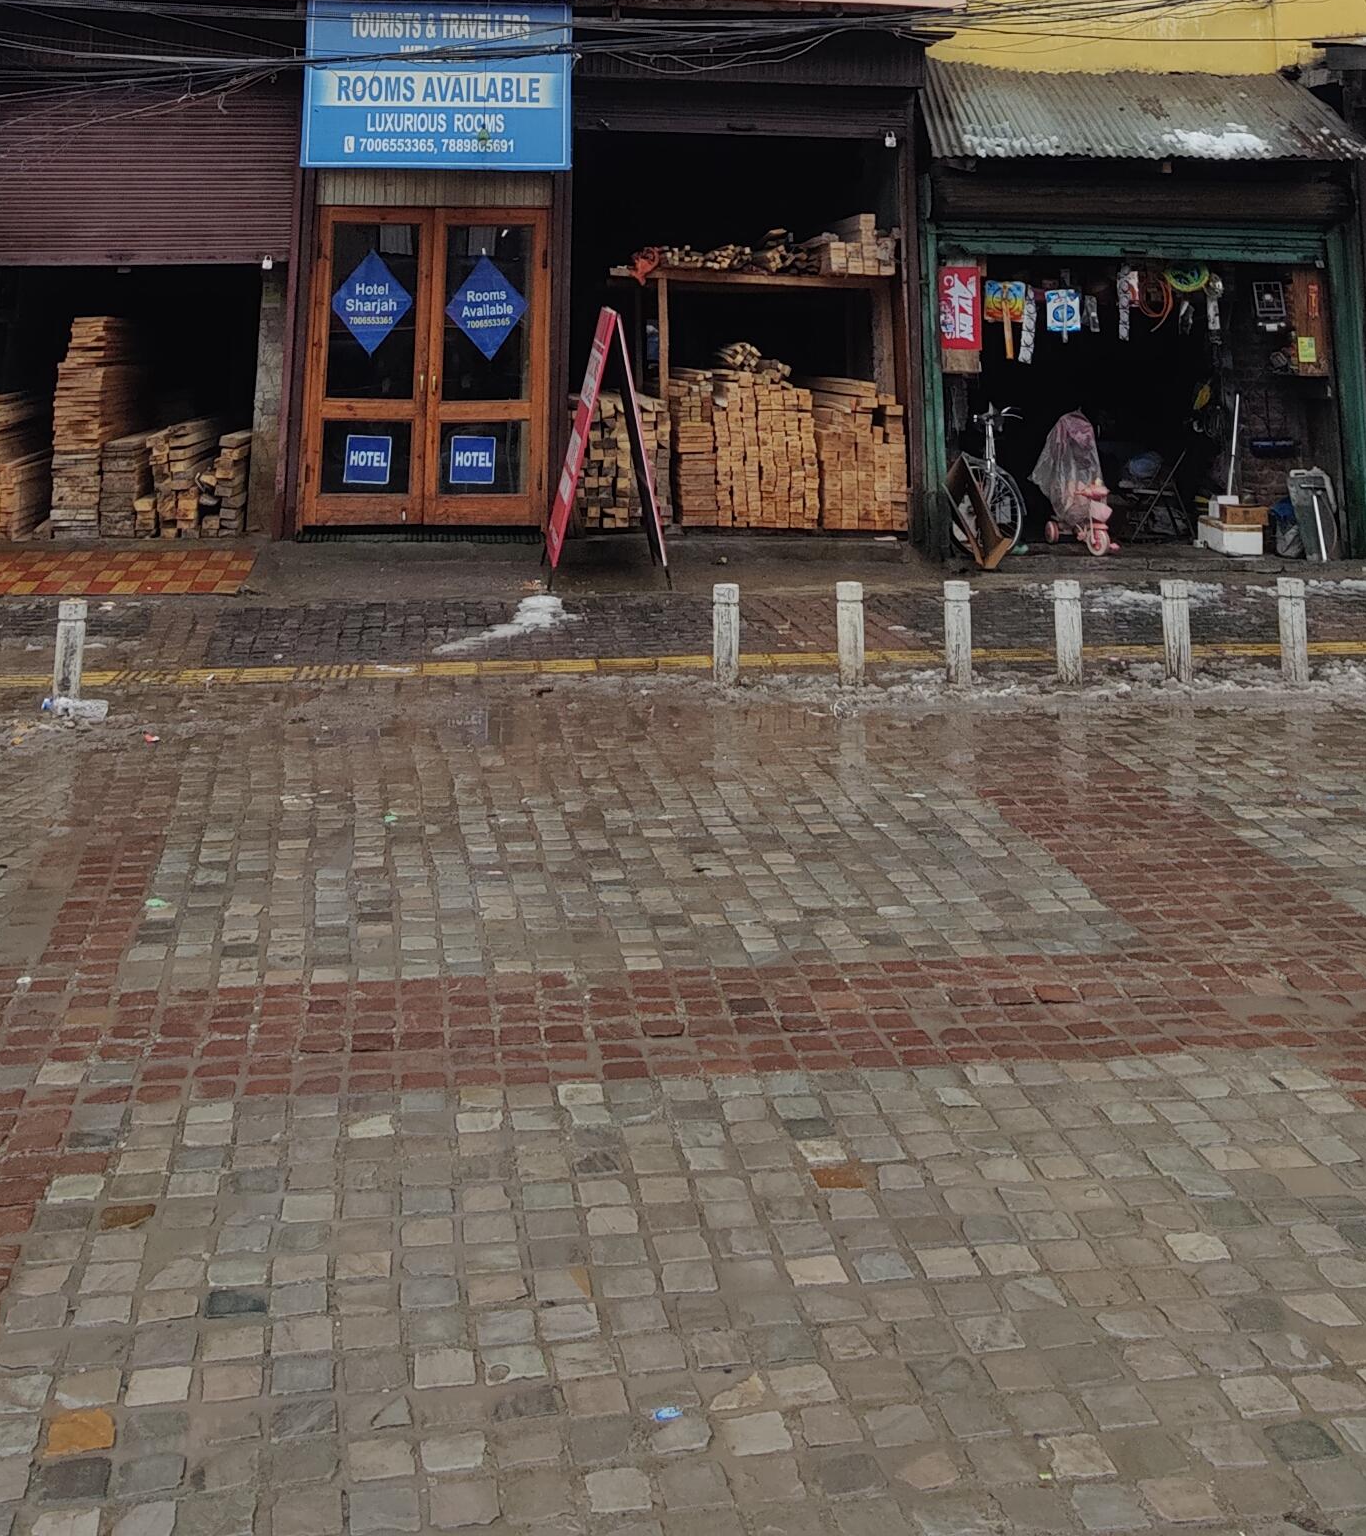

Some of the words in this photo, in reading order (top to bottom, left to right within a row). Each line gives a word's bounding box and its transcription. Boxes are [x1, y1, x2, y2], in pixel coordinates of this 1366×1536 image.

[351, 12, 421, 39] TOURISTS
[426, 13, 437, 39] &
[441, 13, 531, 40] TRAVELLERS
[337, 75, 415, 103] ROOMS
[422, 76, 541, 104] AVAILABLE
[366, 112, 447, 133] LUXURIOUS
[453, 113, 505, 133] ROOMS
[359, 138, 438, 155] 7006553365,
[355, 282, 389, 296] Hotel
[466, 290, 507, 303] Rooms
[345, 298, 398, 314] Sharjah
[461, 303, 514, 318] Available
[348, 316, 393, 325] 7006553365
[466, 318, 511, 329] 7006553365
[349, 450, 388, 467] HOTEL
[455, 451, 493, 468] HOTEL
